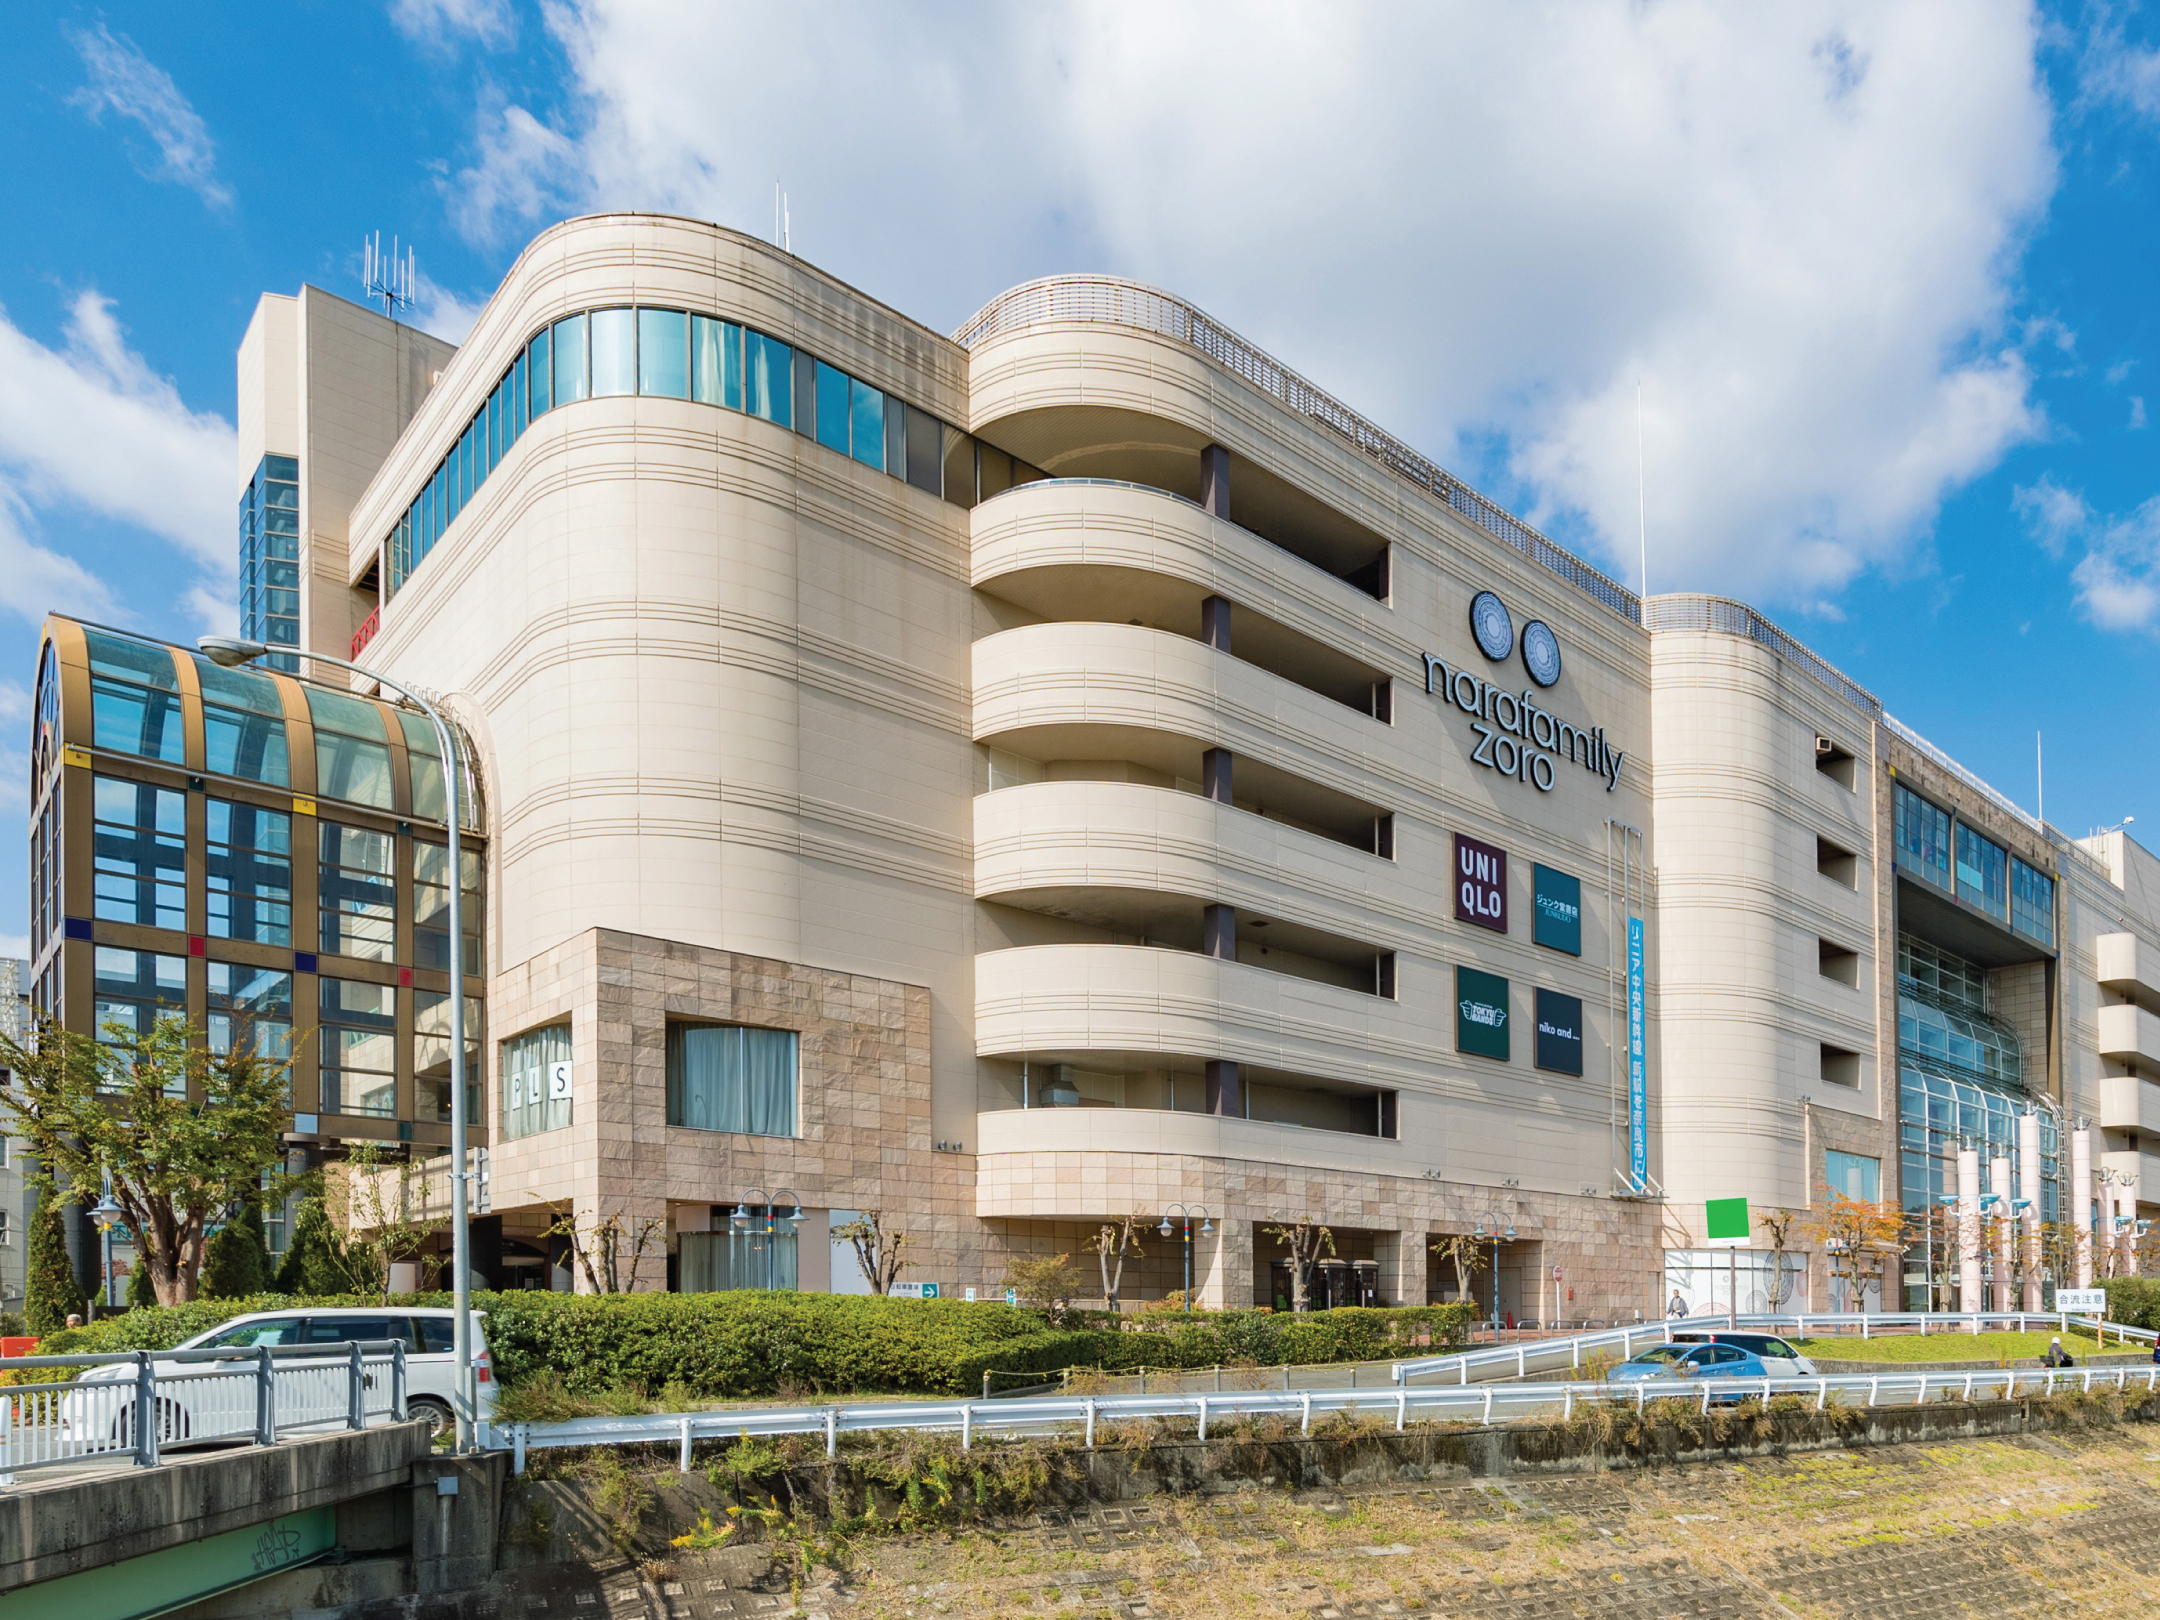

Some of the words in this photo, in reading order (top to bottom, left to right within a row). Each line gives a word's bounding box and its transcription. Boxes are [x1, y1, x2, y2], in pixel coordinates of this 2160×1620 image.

[1421, 652, 1625, 792] narafamily
[1470, 722, 1555, 792] zoro
[1461, 846, 1498, 886] UNI
[1461, 881, 1502, 918] QLO
[1556, 1027, 1572, 1039] and
[2059, 1294, 2104, 1305] 合流注意
